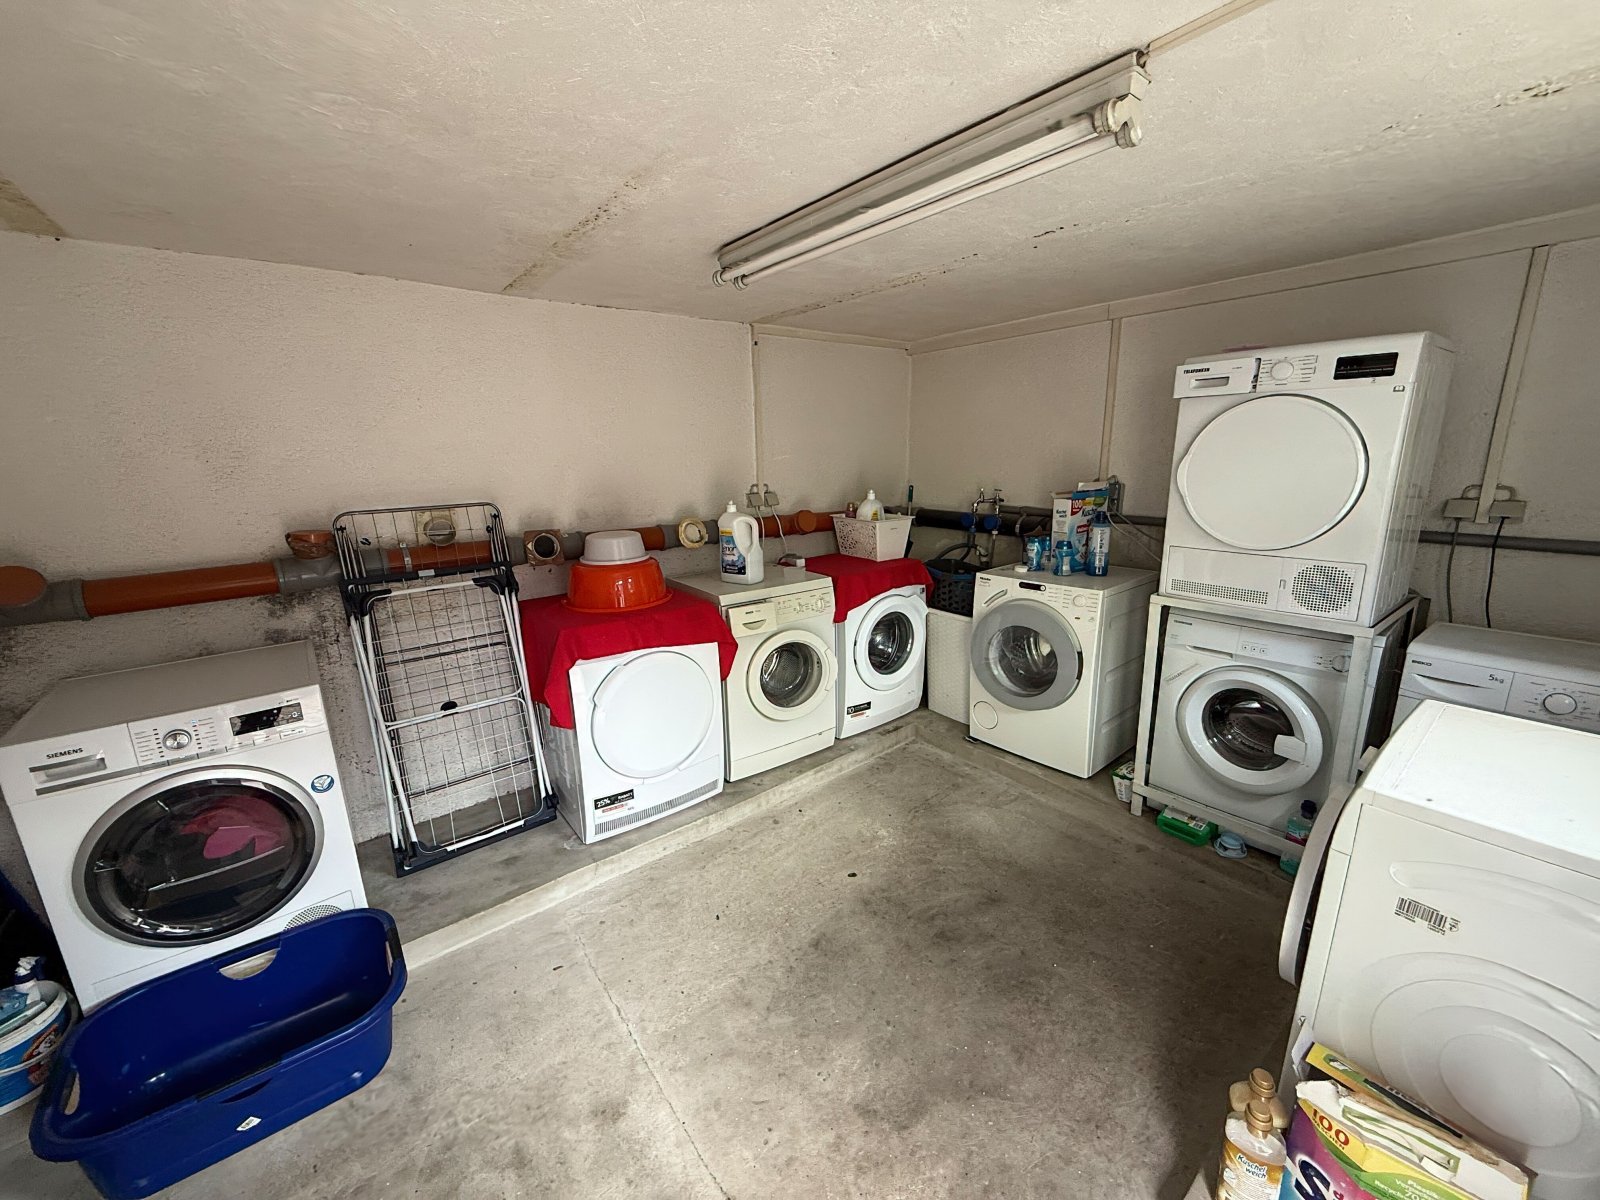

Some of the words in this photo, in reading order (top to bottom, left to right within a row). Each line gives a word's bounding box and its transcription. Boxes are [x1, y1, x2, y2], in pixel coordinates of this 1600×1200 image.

[46, 747, 84, 760] SIEMENS
[1312, 1108, 1350, 1147] 100
[1237, 1154, 1267, 1173] Kuschel
[1245, 1167, 1267, 1179] weich
